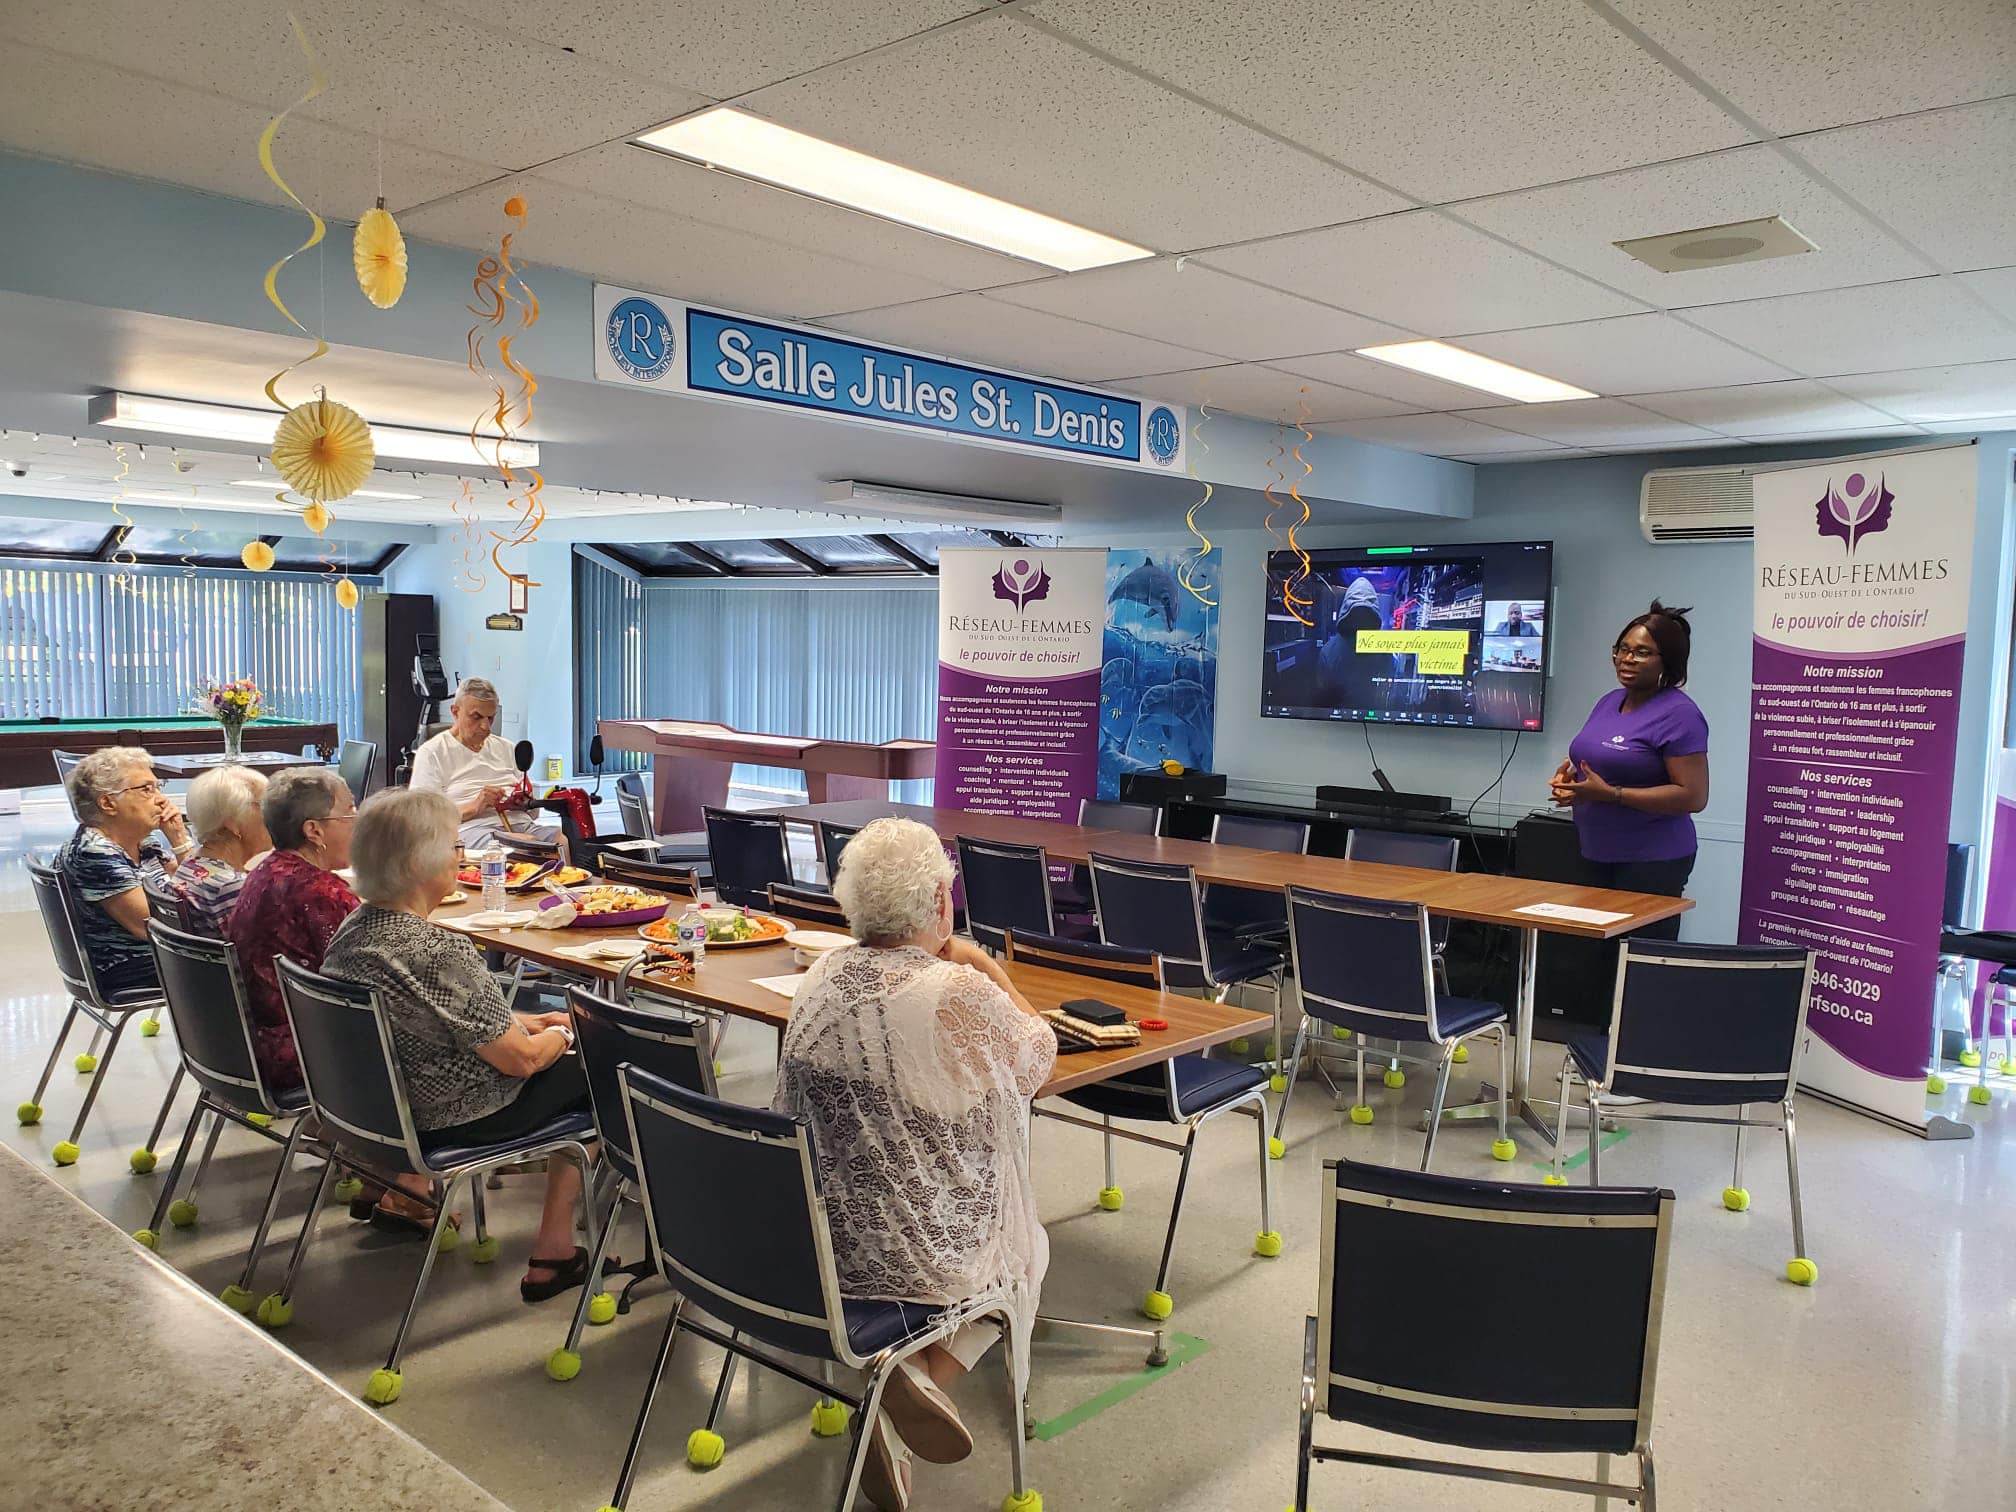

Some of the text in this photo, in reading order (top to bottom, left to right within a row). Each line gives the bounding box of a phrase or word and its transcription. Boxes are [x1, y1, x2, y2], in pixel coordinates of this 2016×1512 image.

[629, 311, 658, 360] R
[717, 327, 836, 400] Salle
[849, 356, 959, 421] Jules
[970, 379, 1021, 434] St.
[1033, 391, 1125, 450] Denis
[1157, 417, 1171, 451] R
[1762, 558, 1949, 588] RÉSEAU-FEMMES
[1784, 591, 1796, 599] DU
[1866, 587, 1915, 597] LONTARIO
[949, 616, 1092, 634] RÉSEAU-FEMMES
[1772, 609, 1928, 633] le pouvoir de choisir!
[1358, 635, 1465, 654] Ne soyez plus jamais
[959, 648, 1080, 664] le pouvoir de choisir!
[1420, 659, 1458, 670] victime
[1803, 665, 1884, 679] Notre mission
[985, 684, 1049, 695] Notre mission
[1856, 685, 1866, 694] les
[1868, 686, 1895, 695] femmes
[1896, 686, 1952, 698] francophones
[1759, 697, 1927, 713] du sud-ouest de l'Ontario de 16 ans et plus, à sortir
[1768, 713, 1795, 722] violence
[1796, 715, 1816, 725] subie,
[1817, 715, 1821, 724] à
[1822, 716, 1841, 725] briser
[1842, 717, 1880, 727] l'isolement
[1881, 720, 1888, 728] et
[1889, 719, 1893, 728] à
[1895, 720, 1936, 731] s'épanouir
[1763, 729, 1915, 747] personnellement et professionnellement grâce
[985, 754, 1043, 765] Nos services
[1772, 743, 1777, 752] à
[1788, 745, 1810, 754] réseau
[1811, 746, 1824, 756] fort,
[1826, 748, 1867, 758] rassembleur
[1868, 751, 1876, 760] et
[1877, 752, 1903, 762] inclusif.
[958, 766, 1069, 777] counselling intervention individuelle
[1800, 769, 1872, 788] Nos services
[964, 776, 1063, 787] coaching mentorat leadership
[956, 786, 972, 794] appui
[974, 786, 1002, 794] transitoire
[1011, 788, 1033, 797] support
[1043, 790, 1071, 798] logement
[1767, 784, 1904, 808] counselling intervention individuelle
[983, 797, 1009, 806] juridique
[1017, 799, 1055, 808] employabilité
[1022, 809, 1061, 819] interprétation
[1773, 800, 1895, 825] coaching mentorat leadership
[1763, 814, 1904, 842] appui transitoire support au logement
[1779, 831, 1885, 855] aide juridique employabilité
[1771, 845, 1890, 872] accompagnement interprétation
[1791, 863, 1869, 885] divorce immigration
[1784, 877, 1874, 902] aiguillage communautaire
[1771, 890, 1886, 922] groupes de soutien réseautage
[1758, 919, 1894, 958] La première référence d'aide aux femmes
[1760, 934, 1894, 974] francoph sud-ouest de l'Ontario!
[1811, 969, 1880, 1001] 946-3029
[1810, 994, 1873, 1026] rfsoo.ca
